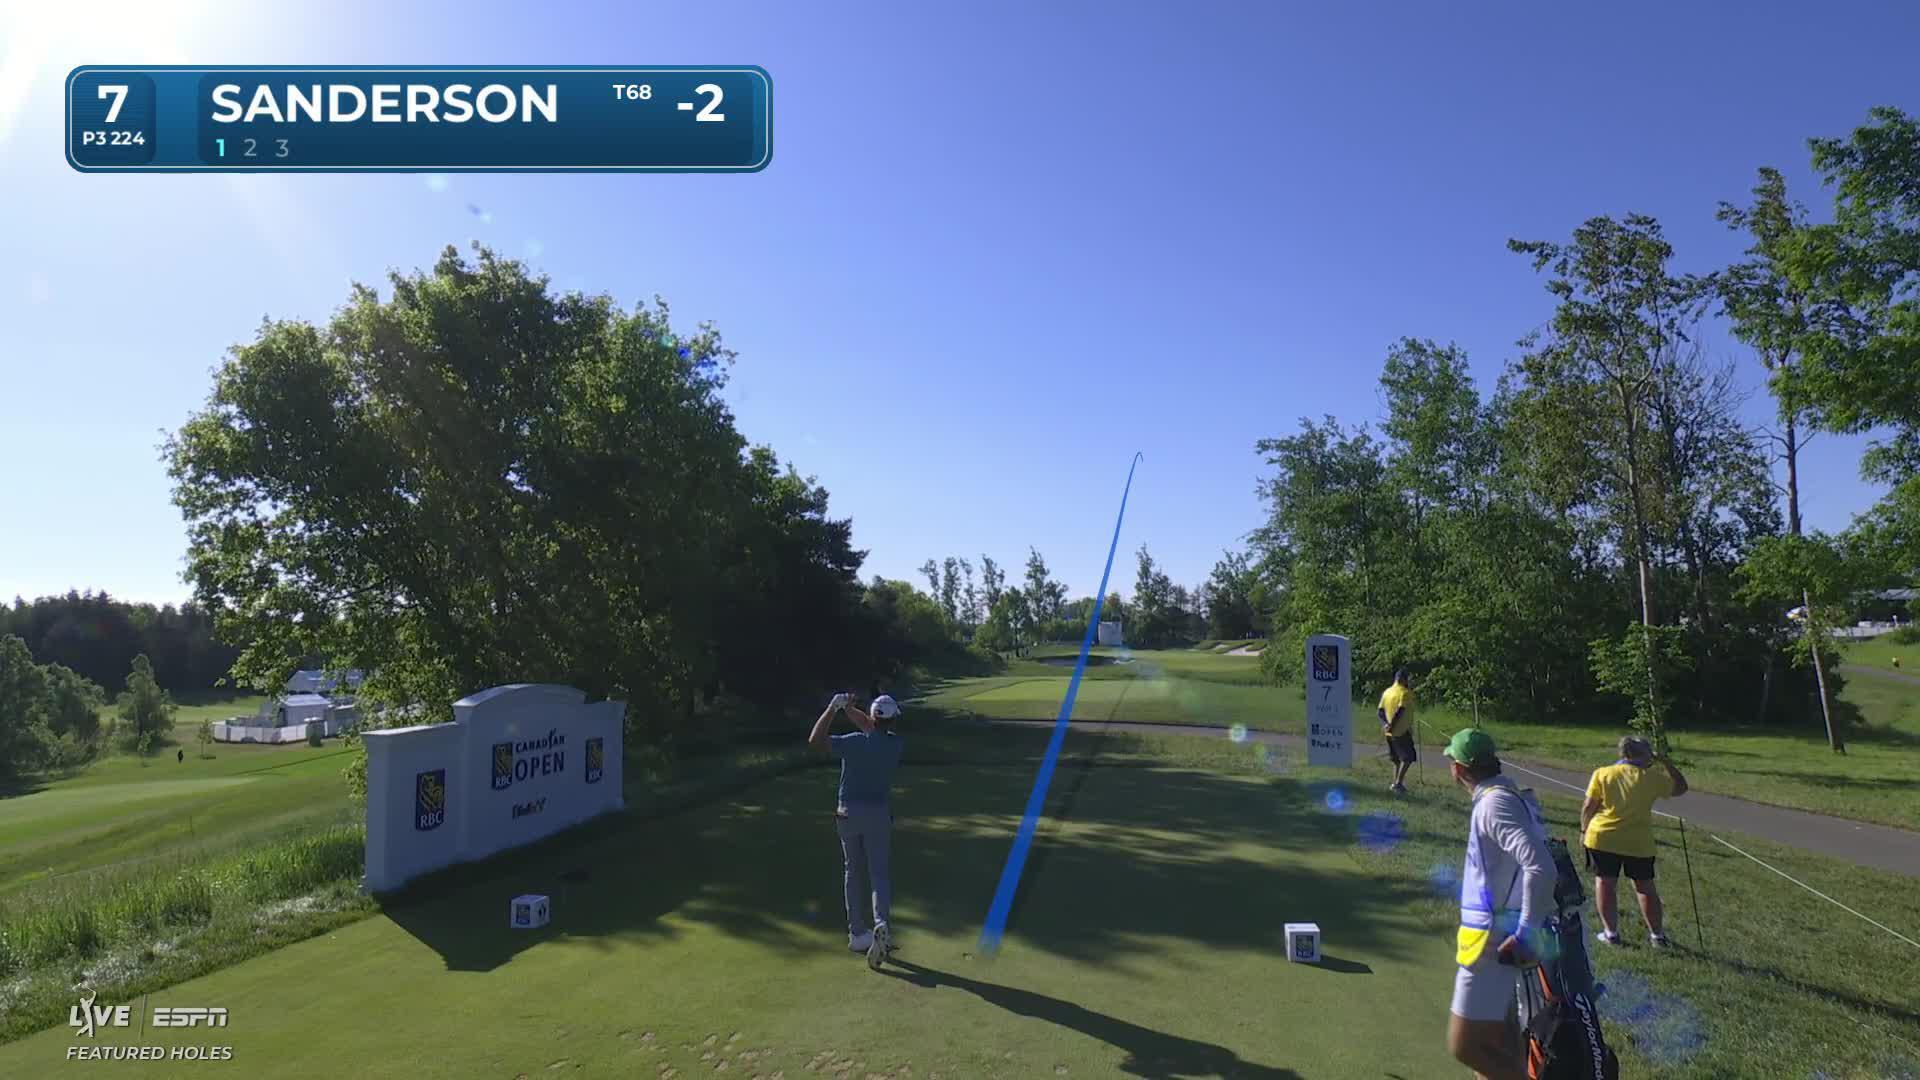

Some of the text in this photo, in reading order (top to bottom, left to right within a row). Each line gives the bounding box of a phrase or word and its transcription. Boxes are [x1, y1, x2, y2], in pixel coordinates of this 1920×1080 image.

[1315, 670, 1337, 680] RBC
[1321, 685, 1332, 702] 7
[516, 729, 565, 753] CANADIAN
[515, 752, 564, 781] OPEN
[495, 774, 512, 786] RBC
[420, 810, 442, 828] RBC
[1574, 992, 1604, 1080] TaylorMad
